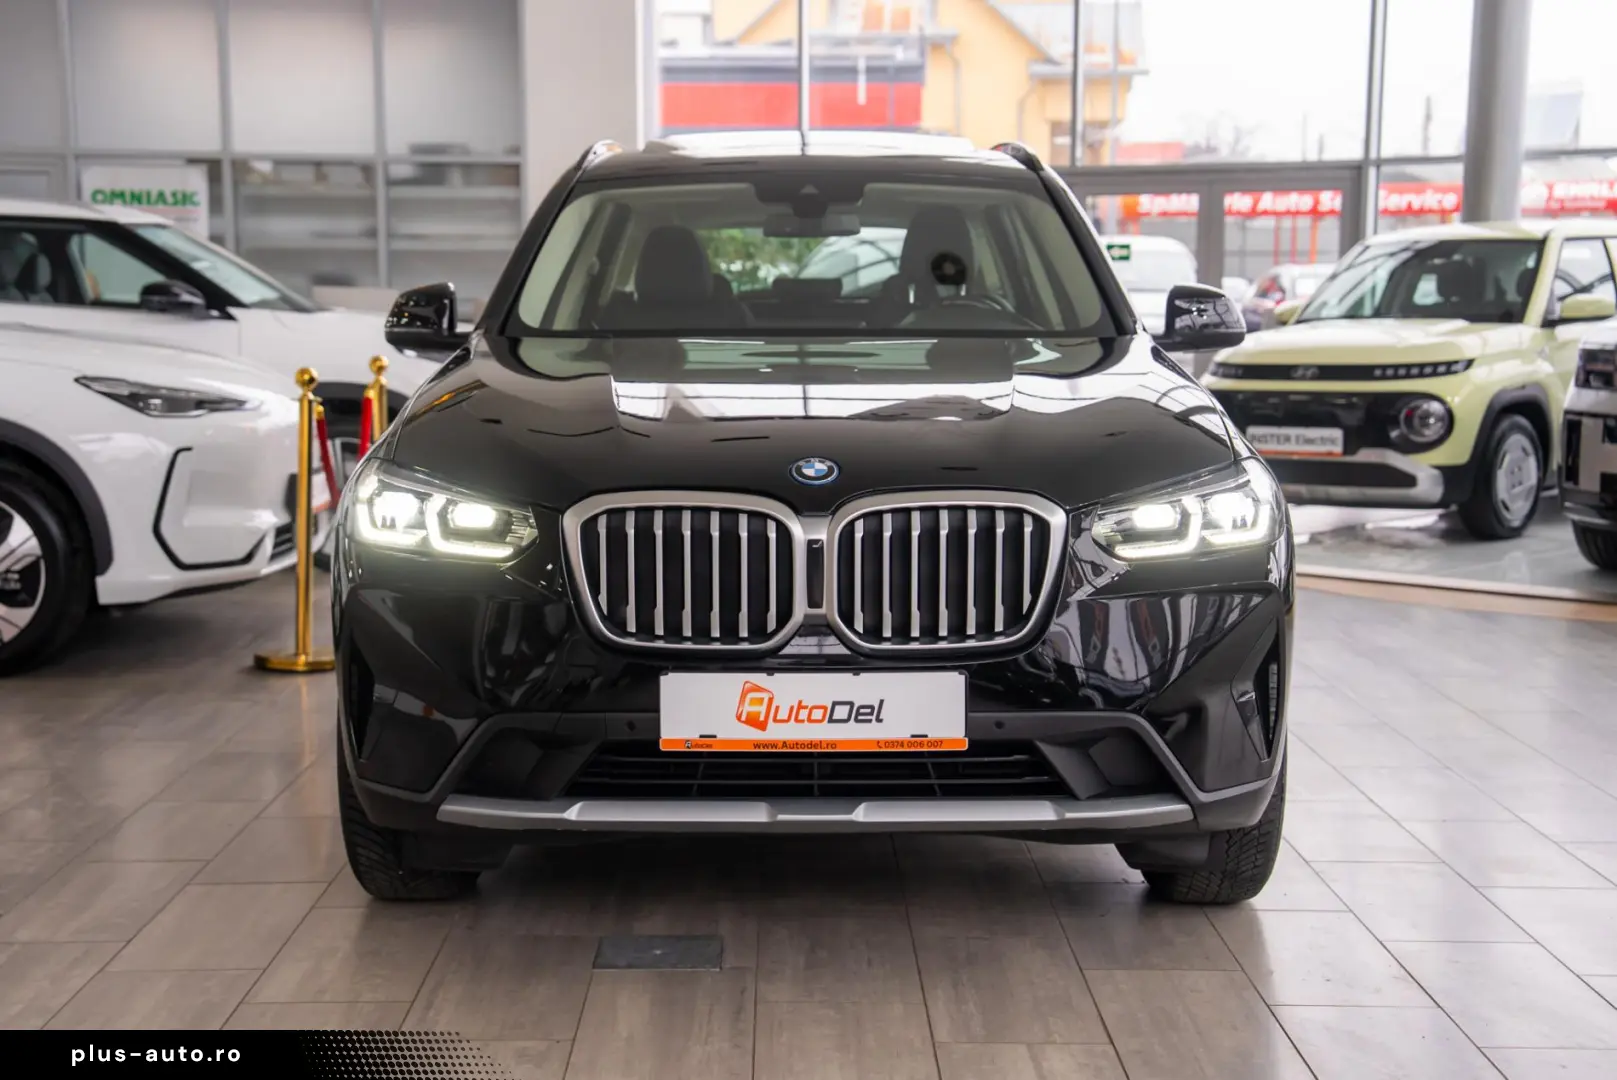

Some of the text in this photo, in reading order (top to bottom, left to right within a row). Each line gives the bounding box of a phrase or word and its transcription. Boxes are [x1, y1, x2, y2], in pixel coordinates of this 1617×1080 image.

[1256, 191, 1315, 212] Auto
[1296, 433, 1339, 446] Electric
[736, 681, 885, 732] AutoDel
[753, 740, 837, 750] www.Autodel.ro
[884, 740, 905, 749] 0374
[907, 740, 924, 748] 006
[927, 740, 943, 748] 007
